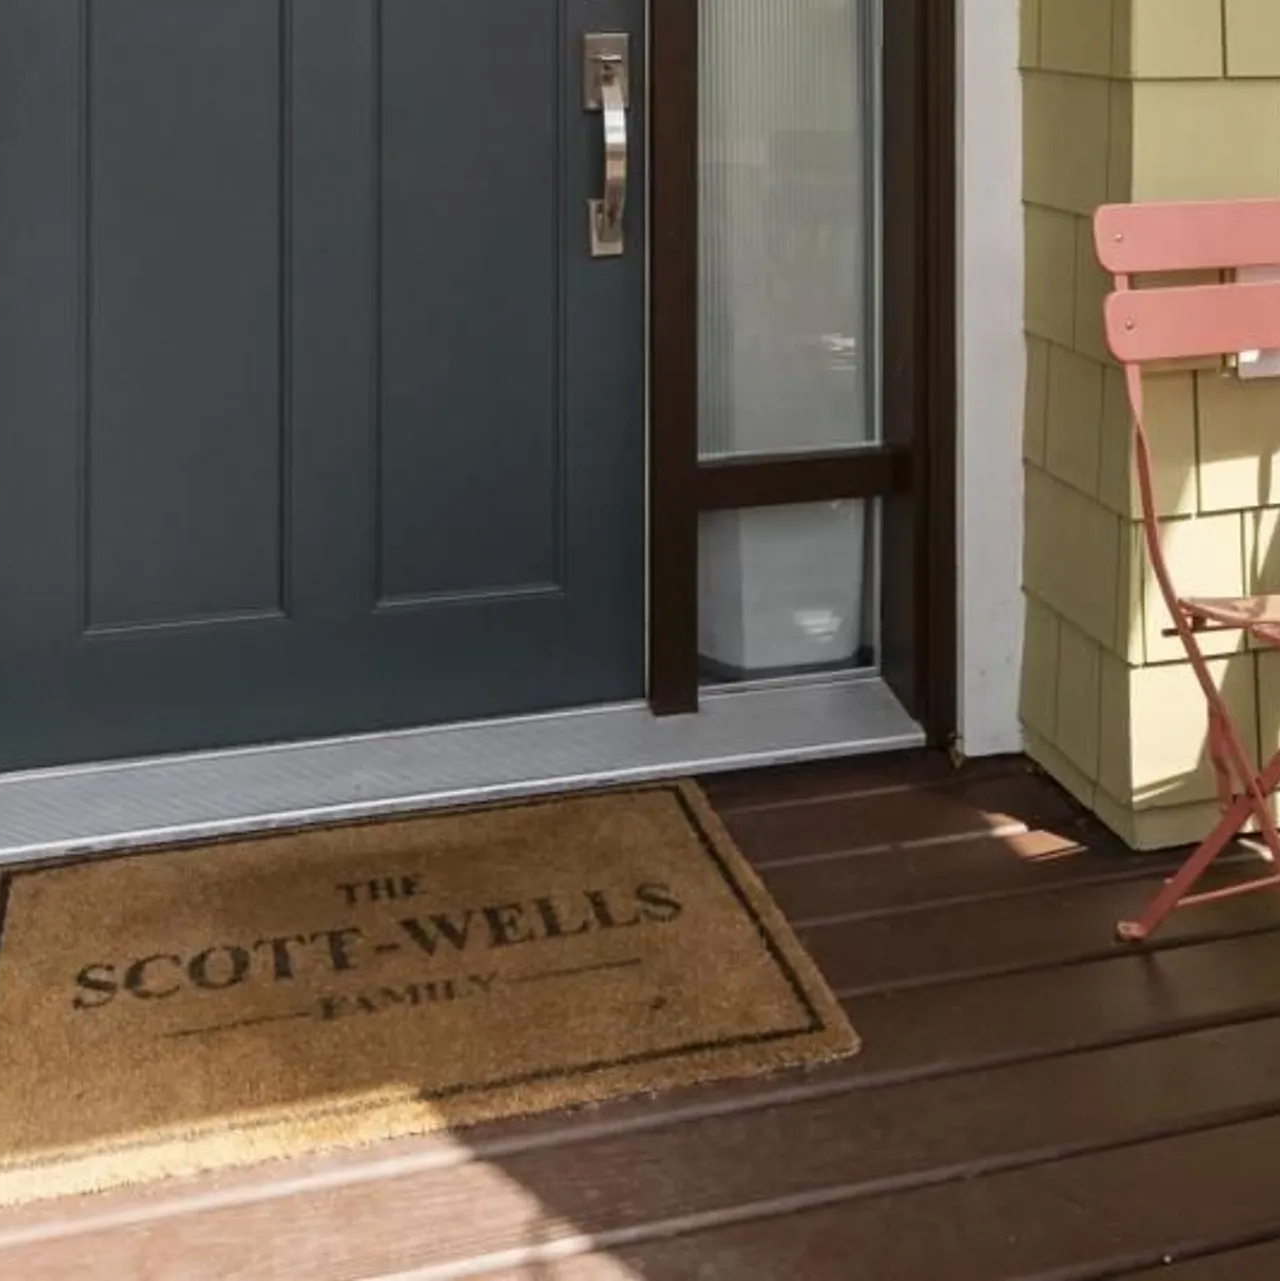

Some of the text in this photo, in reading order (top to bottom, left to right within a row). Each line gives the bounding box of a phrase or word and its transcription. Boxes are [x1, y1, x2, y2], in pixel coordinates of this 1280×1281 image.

[335, 873, 427, 905] THE
[73, 881, 683, 1010] SCOTT-WELLS
[319, 971, 498, 1020] FAMILY
